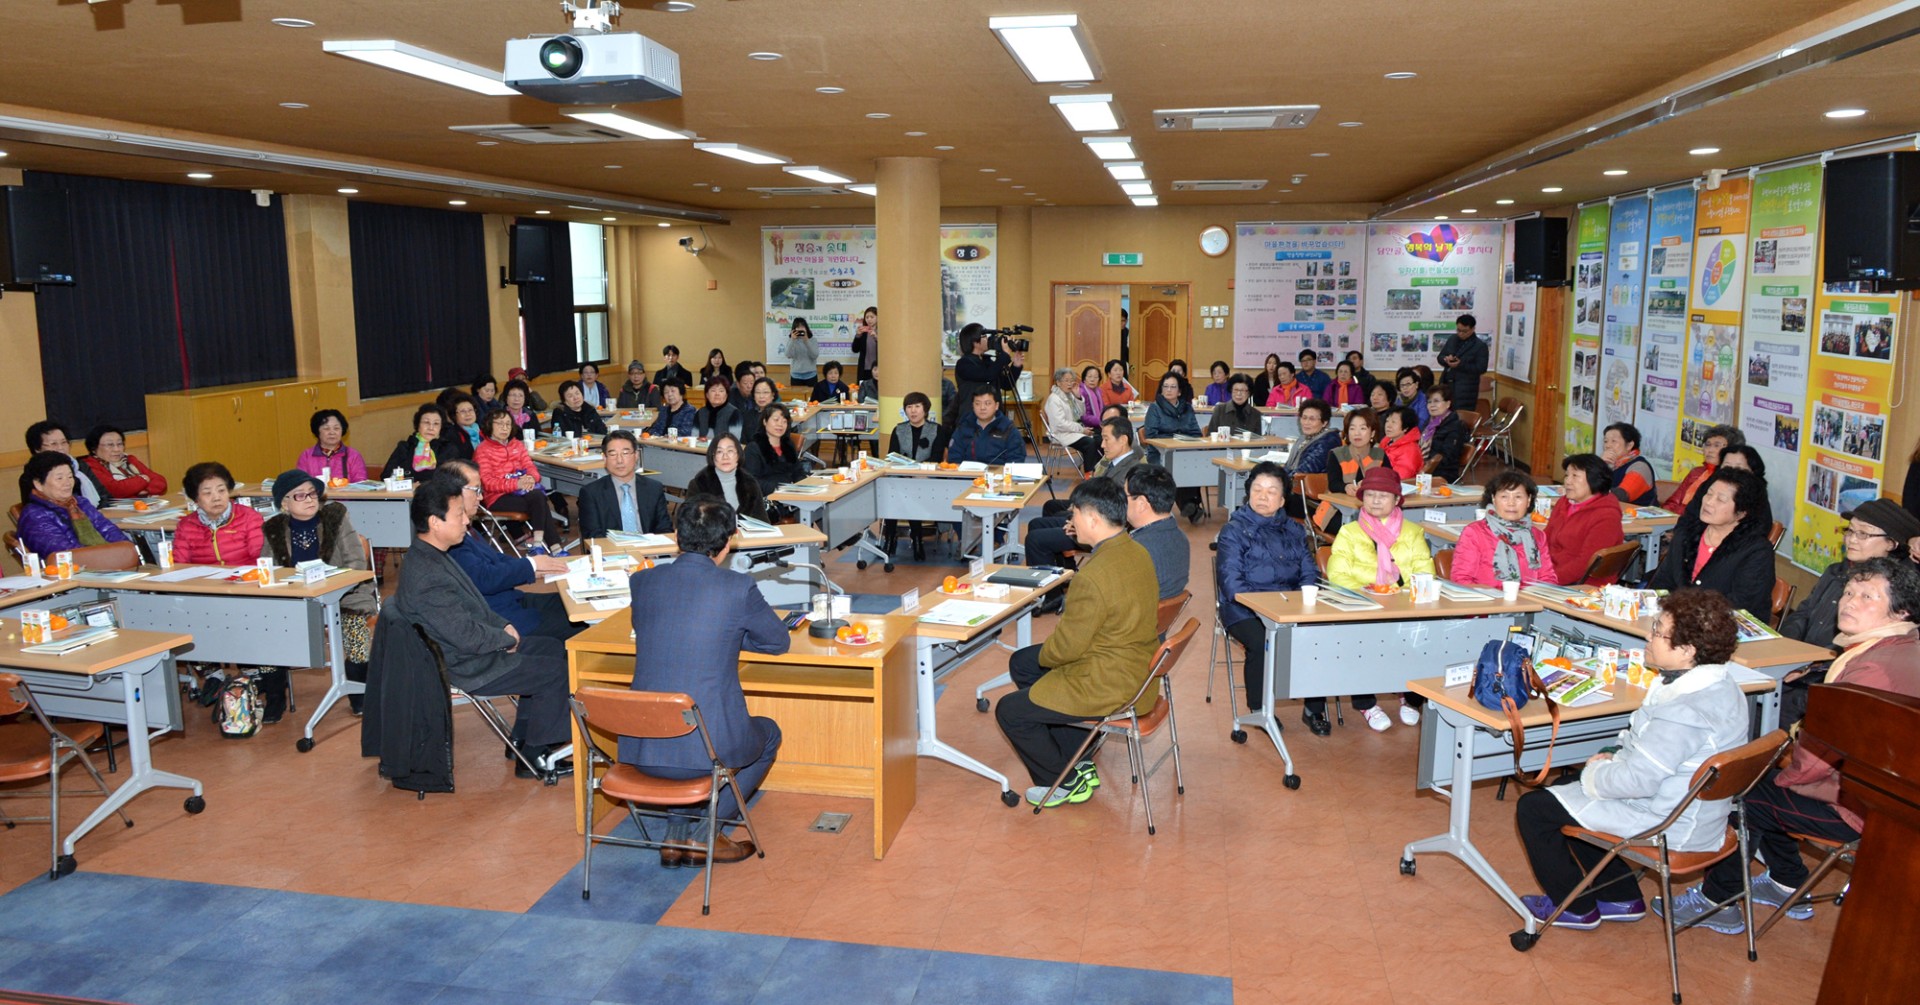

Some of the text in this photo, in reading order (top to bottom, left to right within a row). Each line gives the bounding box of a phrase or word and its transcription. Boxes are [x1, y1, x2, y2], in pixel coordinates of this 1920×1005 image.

[795, 242, 847, 253] 장승과 솟대
[1406, 243, 1432, 253] 행복의
[1435, 243, 1453, 253] 날개
